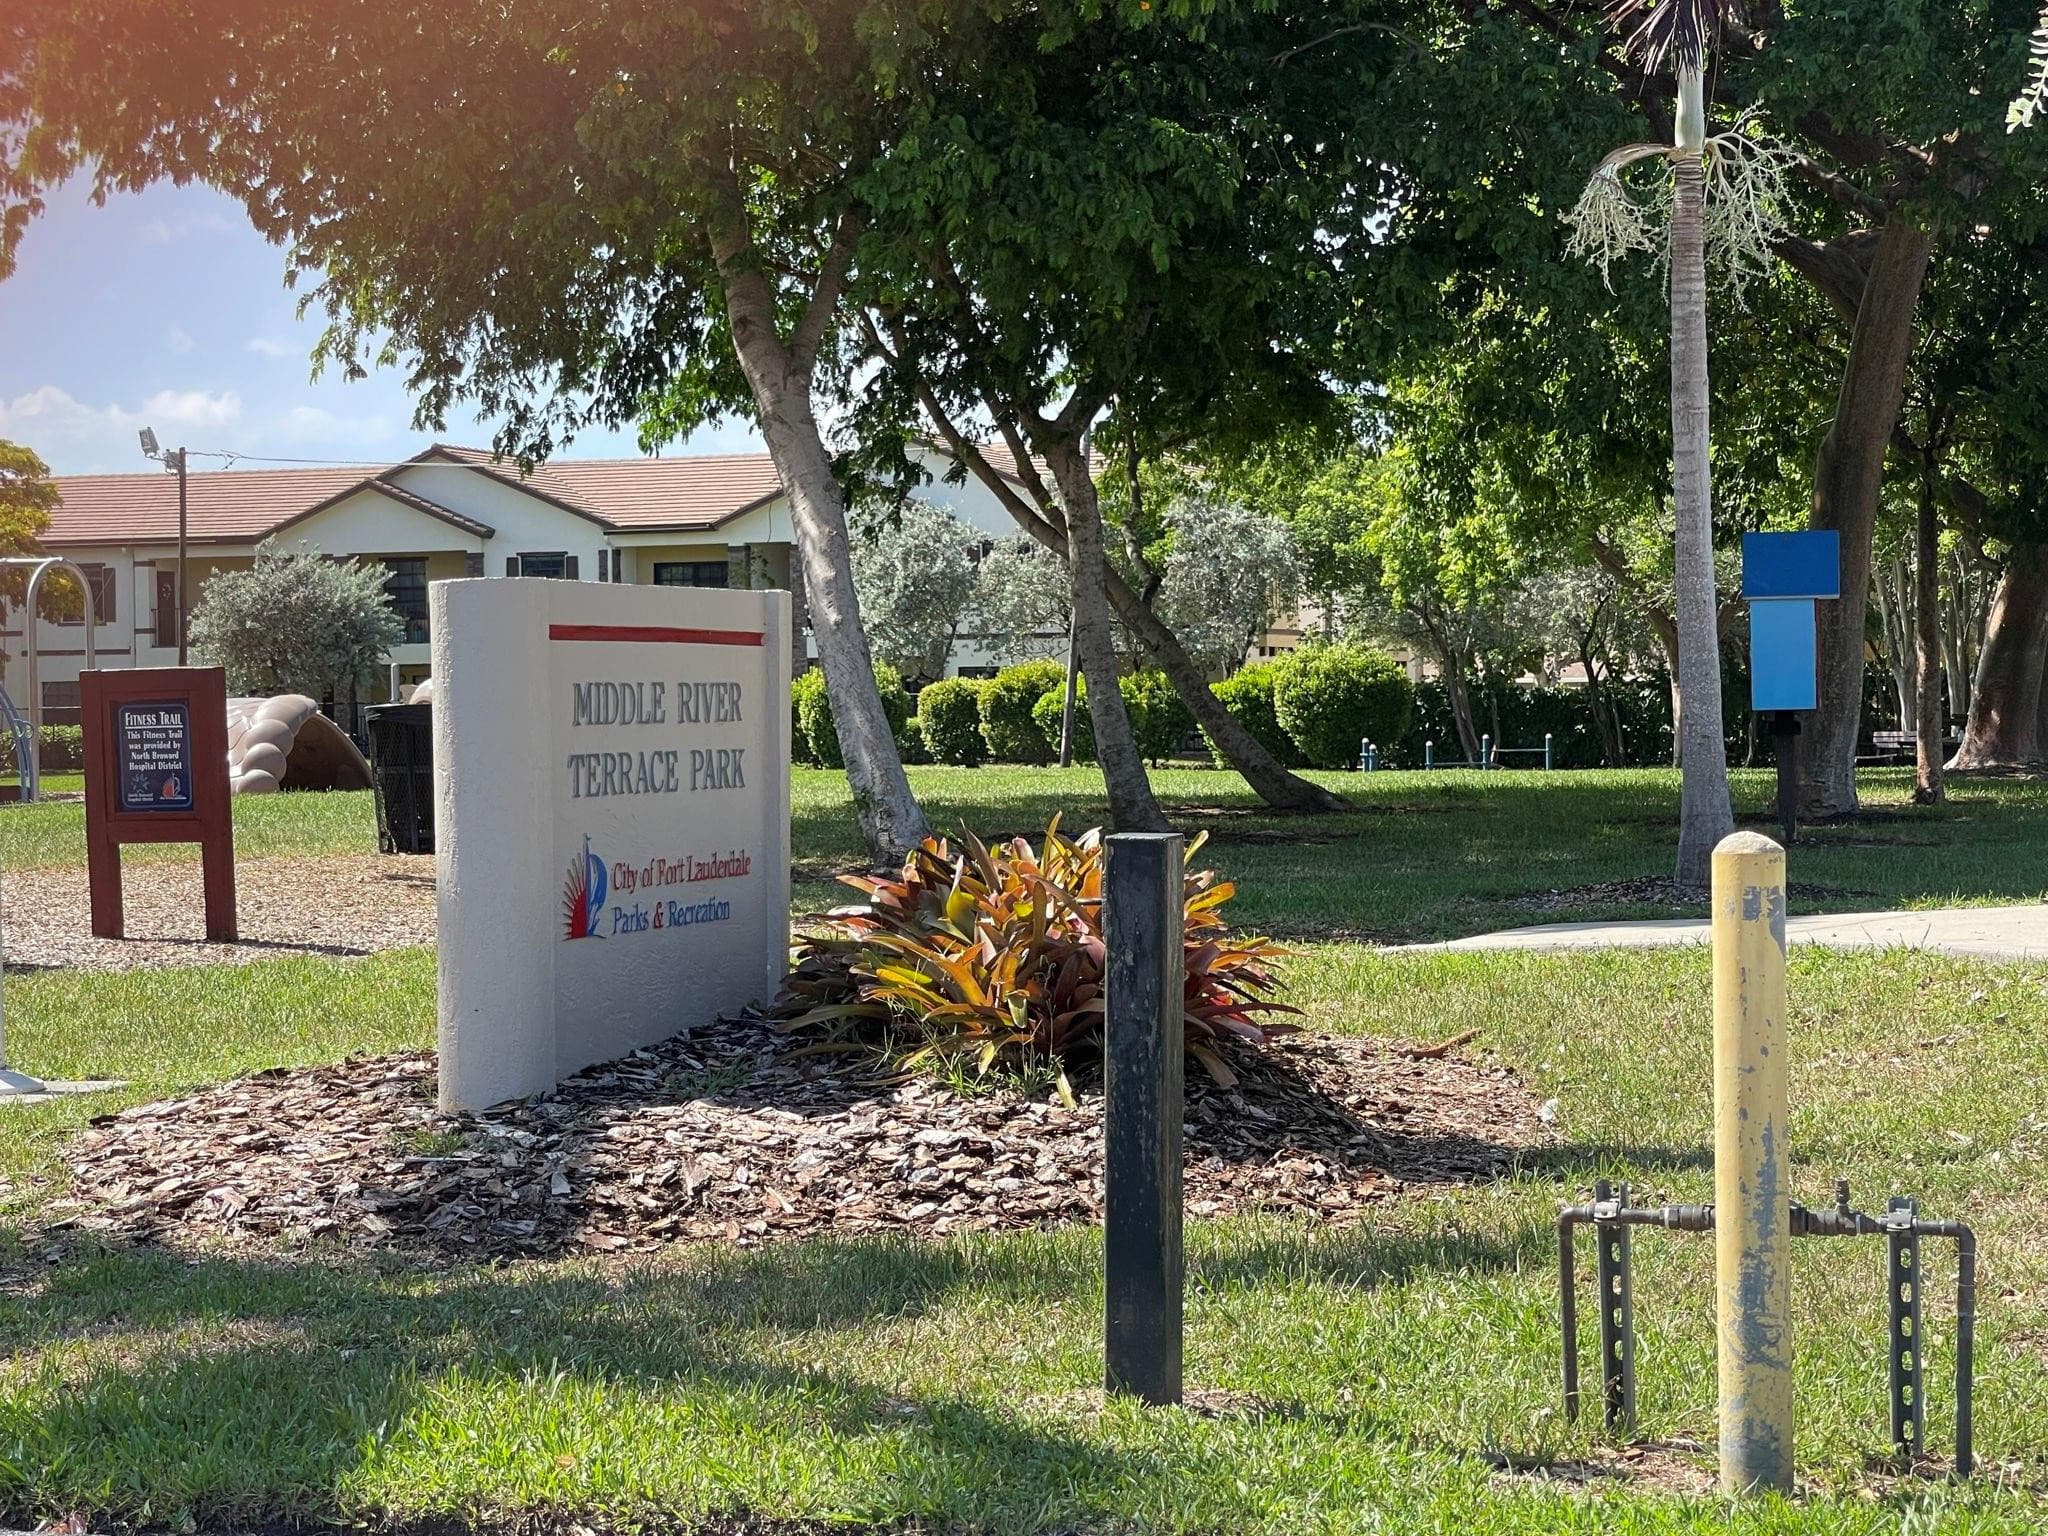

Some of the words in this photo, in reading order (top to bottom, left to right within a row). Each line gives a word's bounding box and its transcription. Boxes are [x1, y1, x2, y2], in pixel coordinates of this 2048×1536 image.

[572, 682, 665, 726] MIDDLE
[678, 682, 742, 723] RIVER
[125, 712, 156, 726] FITNESS
[159, 712, 182, 725] TRAIL
[127, 731, 140, 739] This
[143, 730, 166, 738] Fitness
[169, 730, 183, 738] Trail
[143, 741, 171, 750] provided
[173, 740, 181, 749] by
[131, 752, 150, 760] North
[152, 751, 179, 759] Broward
[129, 762, 156, 772] Hospital
[158, 761, 182, 770] District
[567, 750, 678, 798] TERRACE
[690, 749, 745, 790] PARK
[612, 862, 638, 894] City
[640, 858, 655, 886] of
[658, 858, 684, 886] Fort
[686, 849, 751, 881] Lauderdale
[612, 903, 649, 935] Parks
[653, 901, 664, 928] &
[668, 897, 730, 928] Recreation
